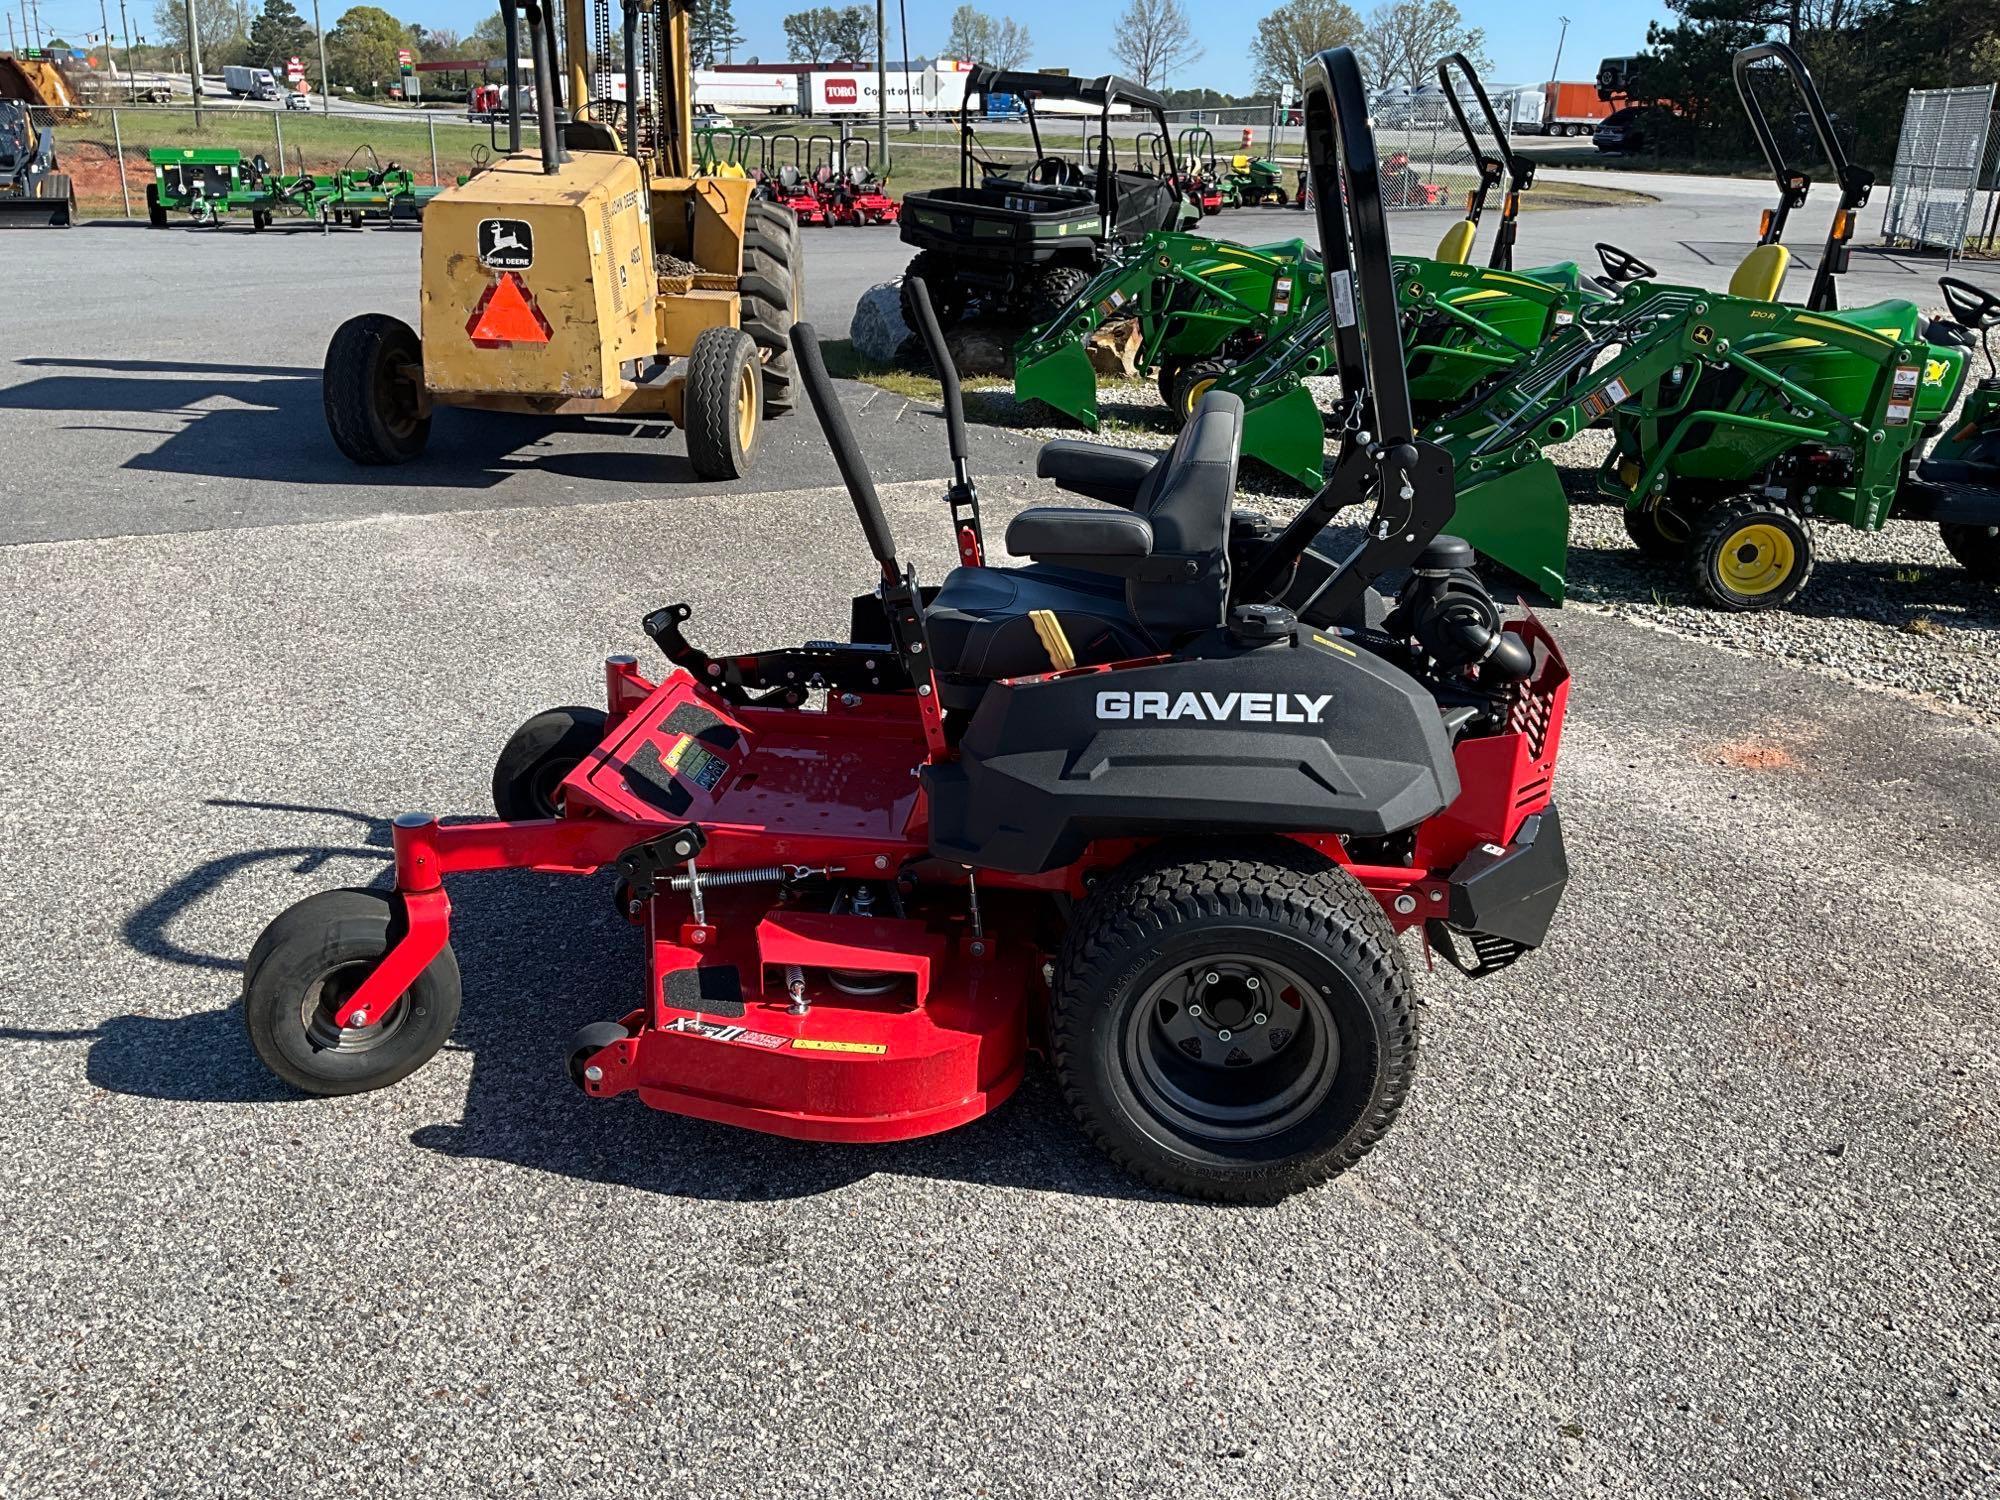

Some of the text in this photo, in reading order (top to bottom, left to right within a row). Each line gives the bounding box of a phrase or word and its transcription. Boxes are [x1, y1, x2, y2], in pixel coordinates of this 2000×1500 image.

[826, 86, 856, 97] TORO
[863, 86, 896, 96] Cont
[1096, 691, 1333, 723] GRAVELY
